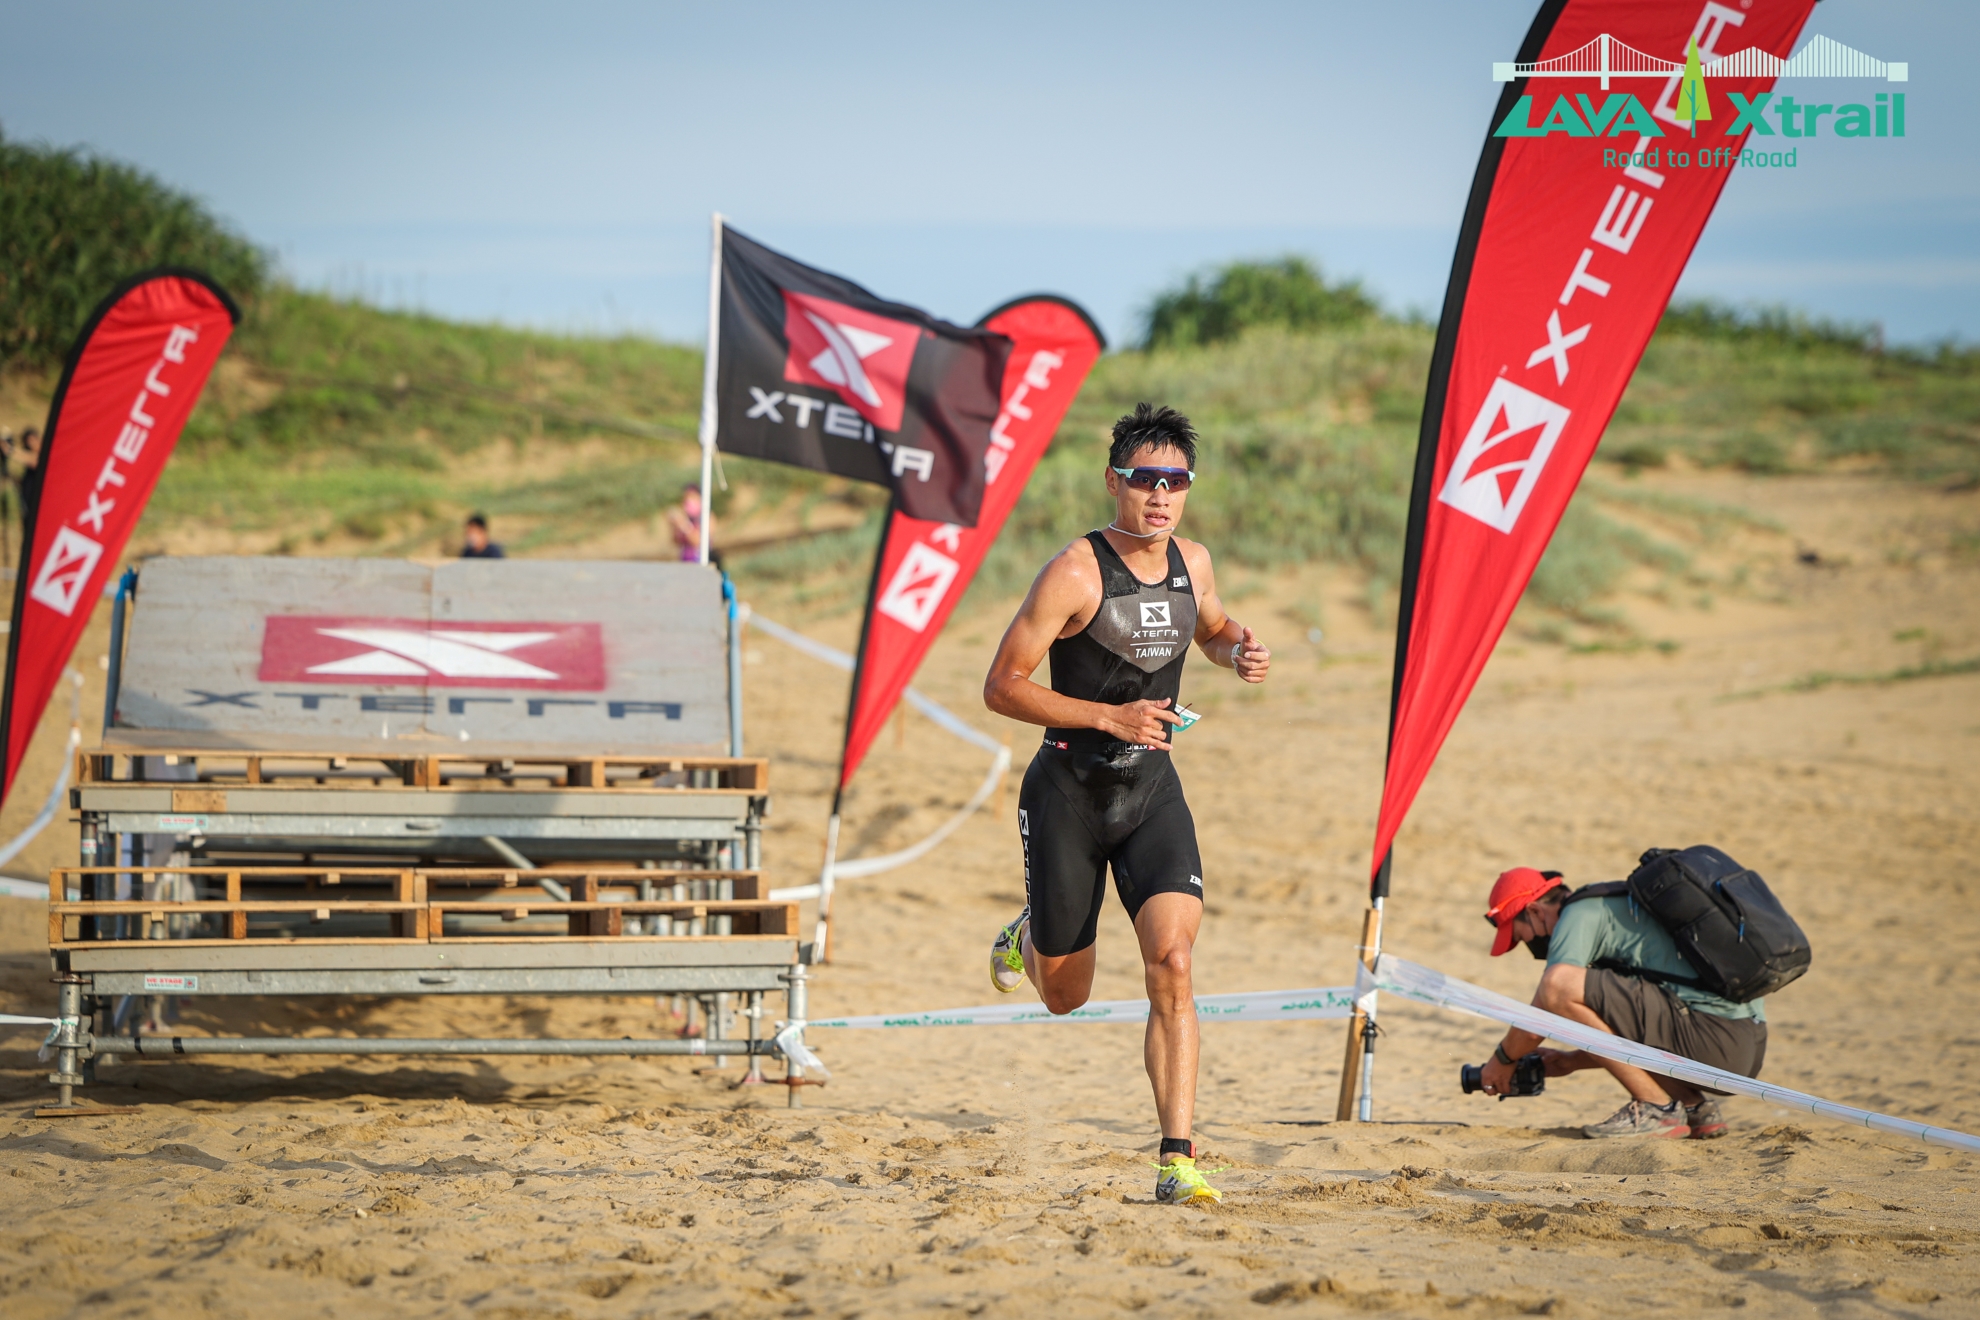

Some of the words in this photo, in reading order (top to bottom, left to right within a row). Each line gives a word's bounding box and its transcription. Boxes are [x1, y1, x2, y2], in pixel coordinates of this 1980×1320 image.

[77, 324, 199, 535] XTERRA
[1131, 629, 1179, 639] XTERRA
[1135, 646, 1172, 659] TAIWAN
[184, 687, 683, 720] XTERRA
